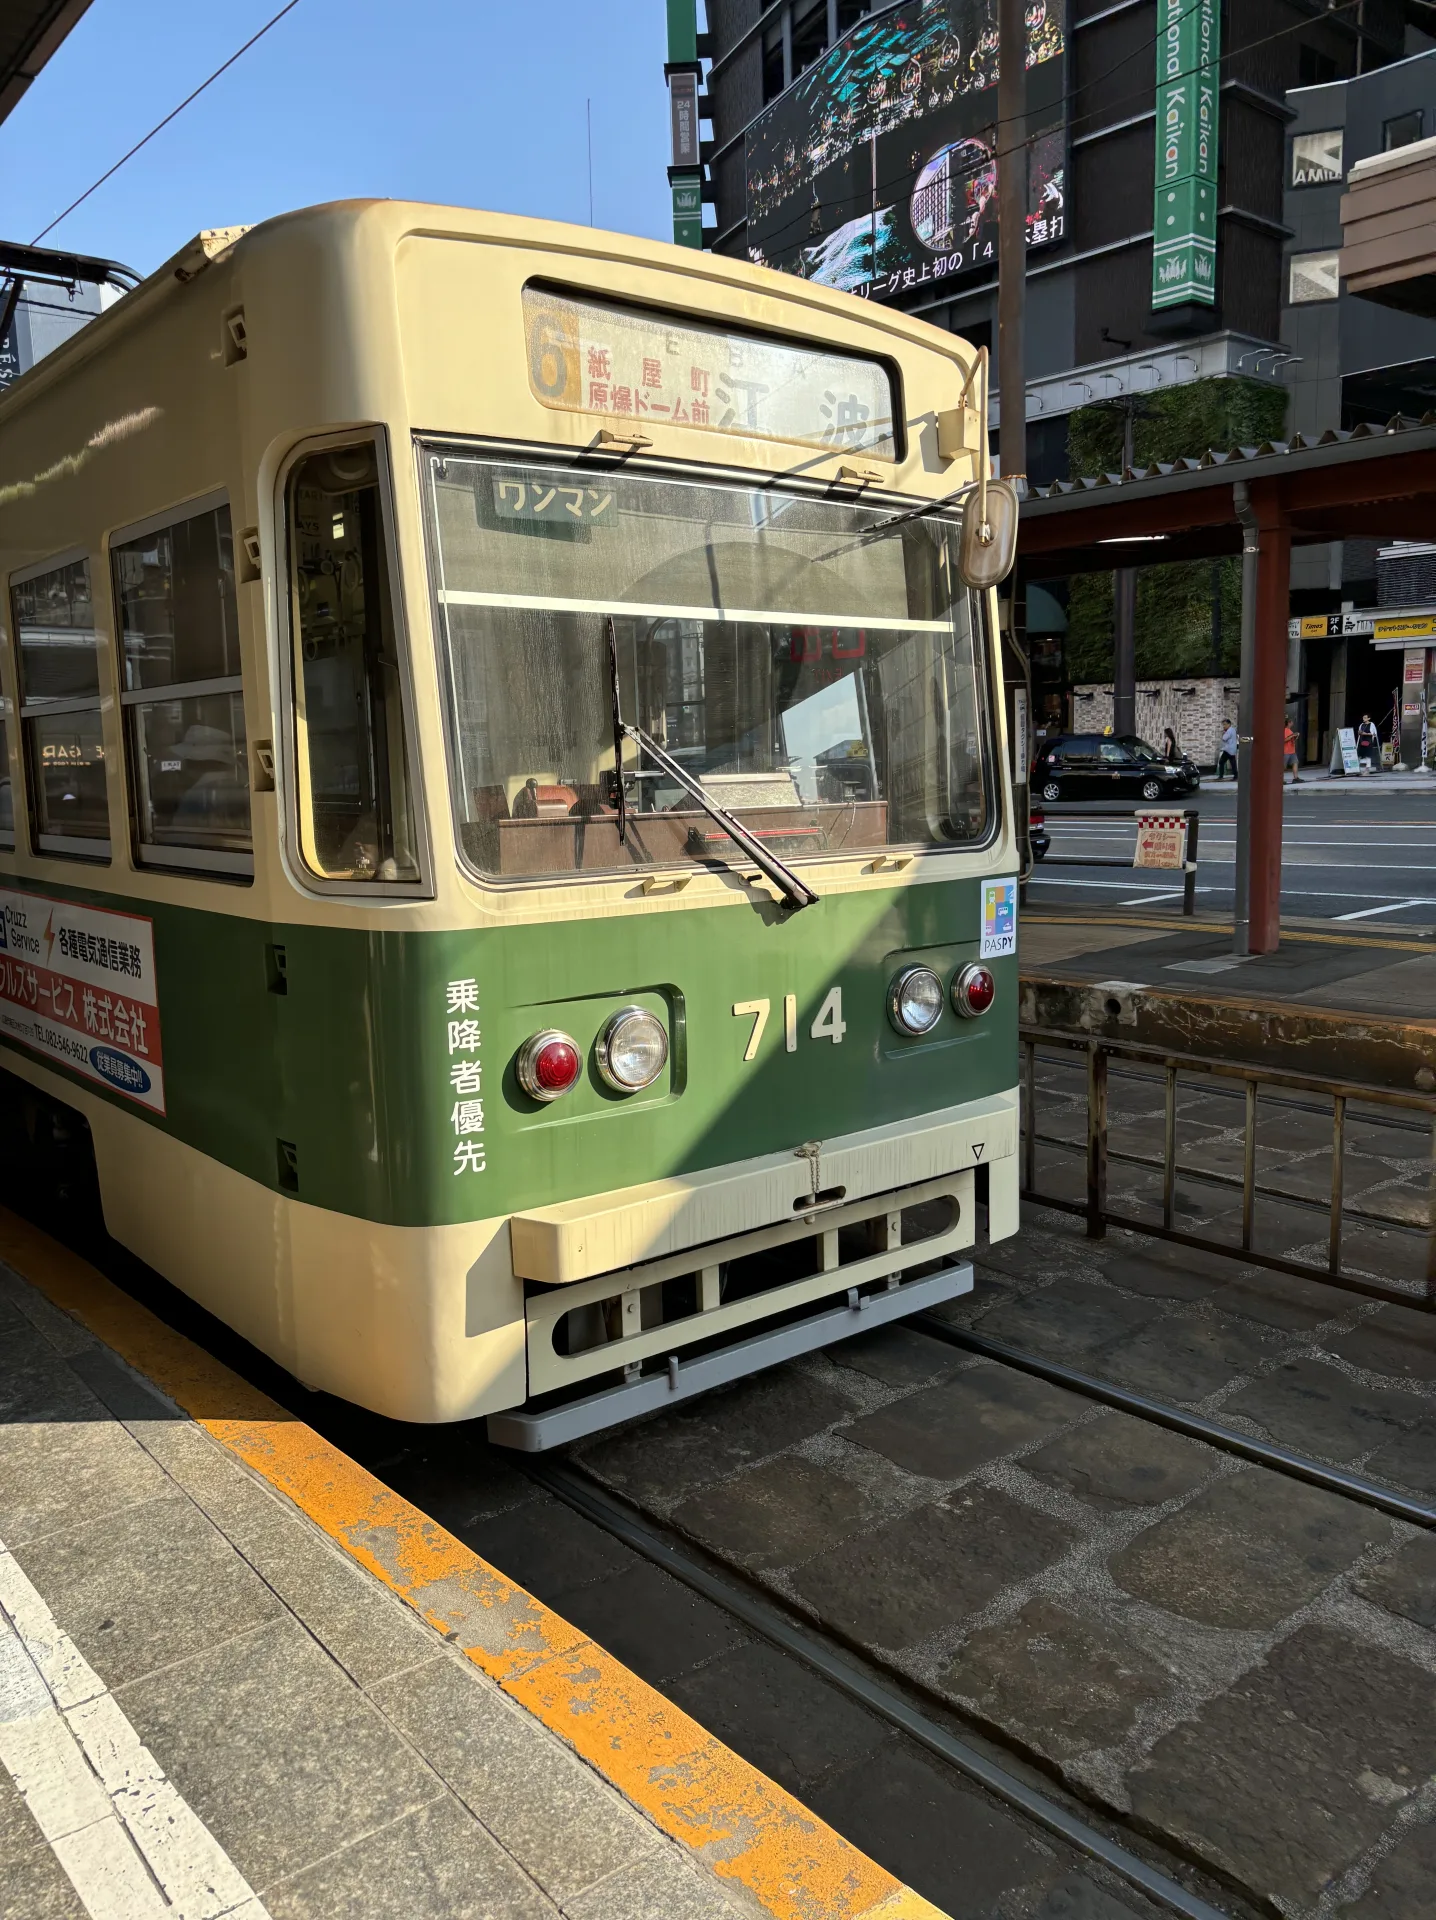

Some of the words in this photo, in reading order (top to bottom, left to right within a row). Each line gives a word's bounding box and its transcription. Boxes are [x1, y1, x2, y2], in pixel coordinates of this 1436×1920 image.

[1165, 86, 1186, 178] Kaikan
[1199, 86, 1212, 174] Kaikan
[529, 312, 568, 397] 6
[587, 345, 711, 398] 紙屋町
[588, 381, 711, 425] 原爆ドーム前
[714, 371, 870, 447] 江波
[499, 480, 613, 517] ワンマン
[1330, 616, 1340, 625] 2F
[5, 905, 28, 929] Cruzz
[11, 928, 40, 955] Service
[58, 926, 142, 979] 各種電気通信業務
[984, 936, 1013, 952] PASPY
[83, 987, 149, 1055] 株式会社
[731, 986, 847, 1061] 714
[445, 977, 486, 1177] 乗降者優先
